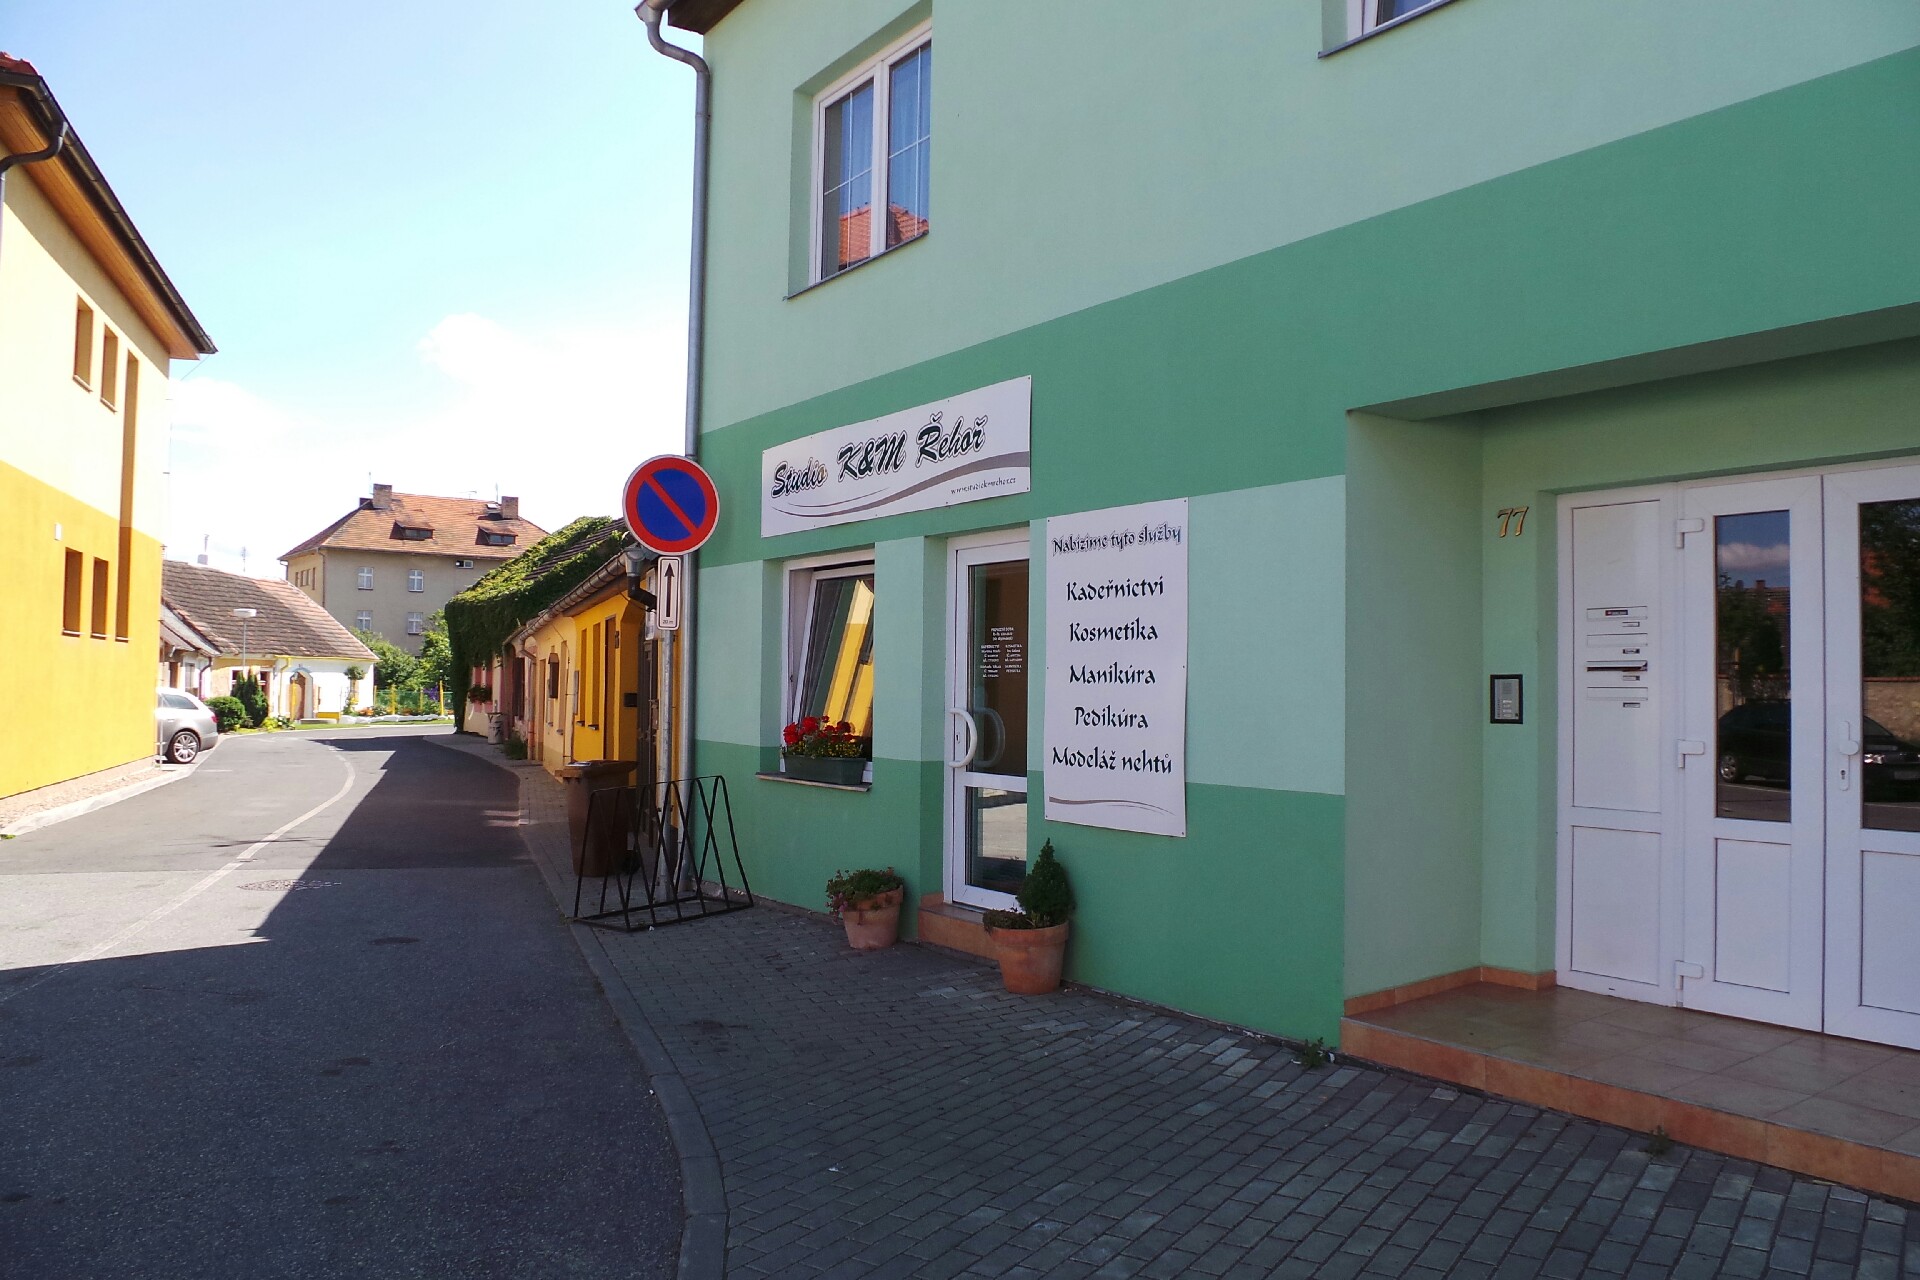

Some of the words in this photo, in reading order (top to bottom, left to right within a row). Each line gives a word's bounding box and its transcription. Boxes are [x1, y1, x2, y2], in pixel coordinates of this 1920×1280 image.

[771, 457, 828, 498] Studio
[837, 430, 907, 482] K&M
[916, 411, 988, 468] Řehoř
[1497, 506, 1529, 538] 77
[1110, 528, 1136, 552] tyto
[1138, 521, 1182, 546] služby
[1066, 575, 1164, 602] Kadeřnictví
[1069, 617, 1159, 643] Kosmetika
[1069, 662, 1156, 685] Manikúra
[1074, 705, 1149, 729] Pedikúra
[1052, 746, 1117, 771] Modeláž
[1121, 748, 1173, 775] nehtů
